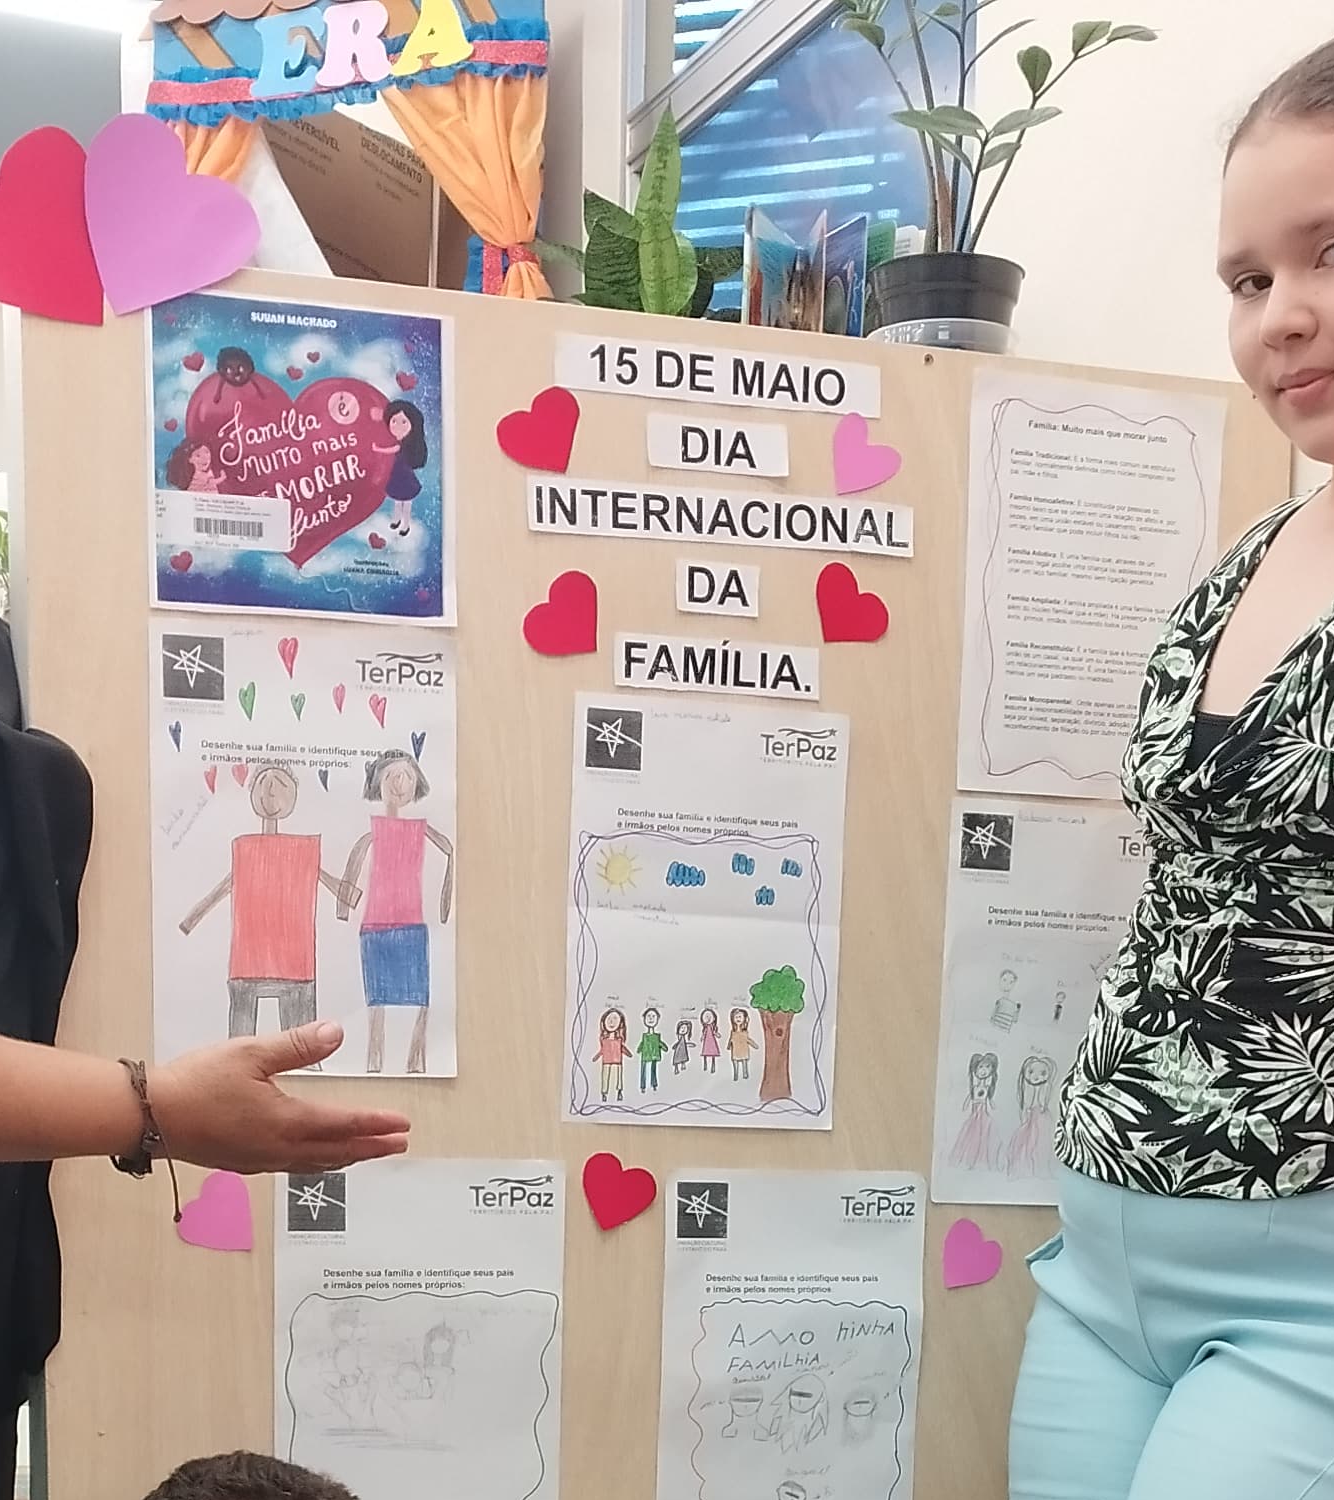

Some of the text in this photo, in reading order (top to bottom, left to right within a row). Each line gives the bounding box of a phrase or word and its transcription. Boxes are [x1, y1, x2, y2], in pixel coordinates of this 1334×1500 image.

[250, 0, 474, 98] ERA
[287, 315, 337, 328] MACHADO
[589, 344, 846, 406] 15 DE MAIO
[1062, 424, 1084, 434] Muito
[1086, 428, 1104, 436] mais
[1107, 430, 1121, 439] que
[1123, 432, 1145, 441] morar
[1147, 434, 1168, 444] junto
[681, 425, 757, 469] DIA
[238, 447, 301, 482] MUITO
[275, 455, 366, 502] MORAR
[535, 485, 910, 549] INTERNACIONAL
[687, 565, 750, 607] DA
[355, 659, 444, 687] TerPaz
[623, 638, 811, 692] FAMÍLIA.
[201, 739, 243, 751] Desenhe
[246, 744, 263, 752] sua
[308, 745, 357, 757] identifique
[360, 749, 382, 758] seus
[760, 734, 837, 760] TerPaz
[245, 755, 270, 766] pelos
[617, 807, 656, 819] Desenhe
[714, 815, 758, 827] identifique
[760, 819, 779, 827] seus
[781, 820, 799, 829] pais
[656, 823, 680, 832] pelos
[682, 826, 712, 834] nomes
[988, 905, 1023, 915] Desenhe
[469, 1186, 554, 1207] TerPaz
[841, 1196, 915, 1216] TerPaz
[323, 1269, 363, 1278] Desenhe
[424, 1268, 471, 1279] identifique
[496, 1269, 514, 1279] pais
[706, 1273, 742, 1282] Desenhe
[796, 1274, 839, 1284] identifique
[862, 1274, 879, 1283] pais
[331, 1281, 363, 1289] irmãos
[365, 1281, 390, 1291] pelos
[425, 1281, 465, 1291] próprios:
[743, 1285, 766, 1295] pelos
